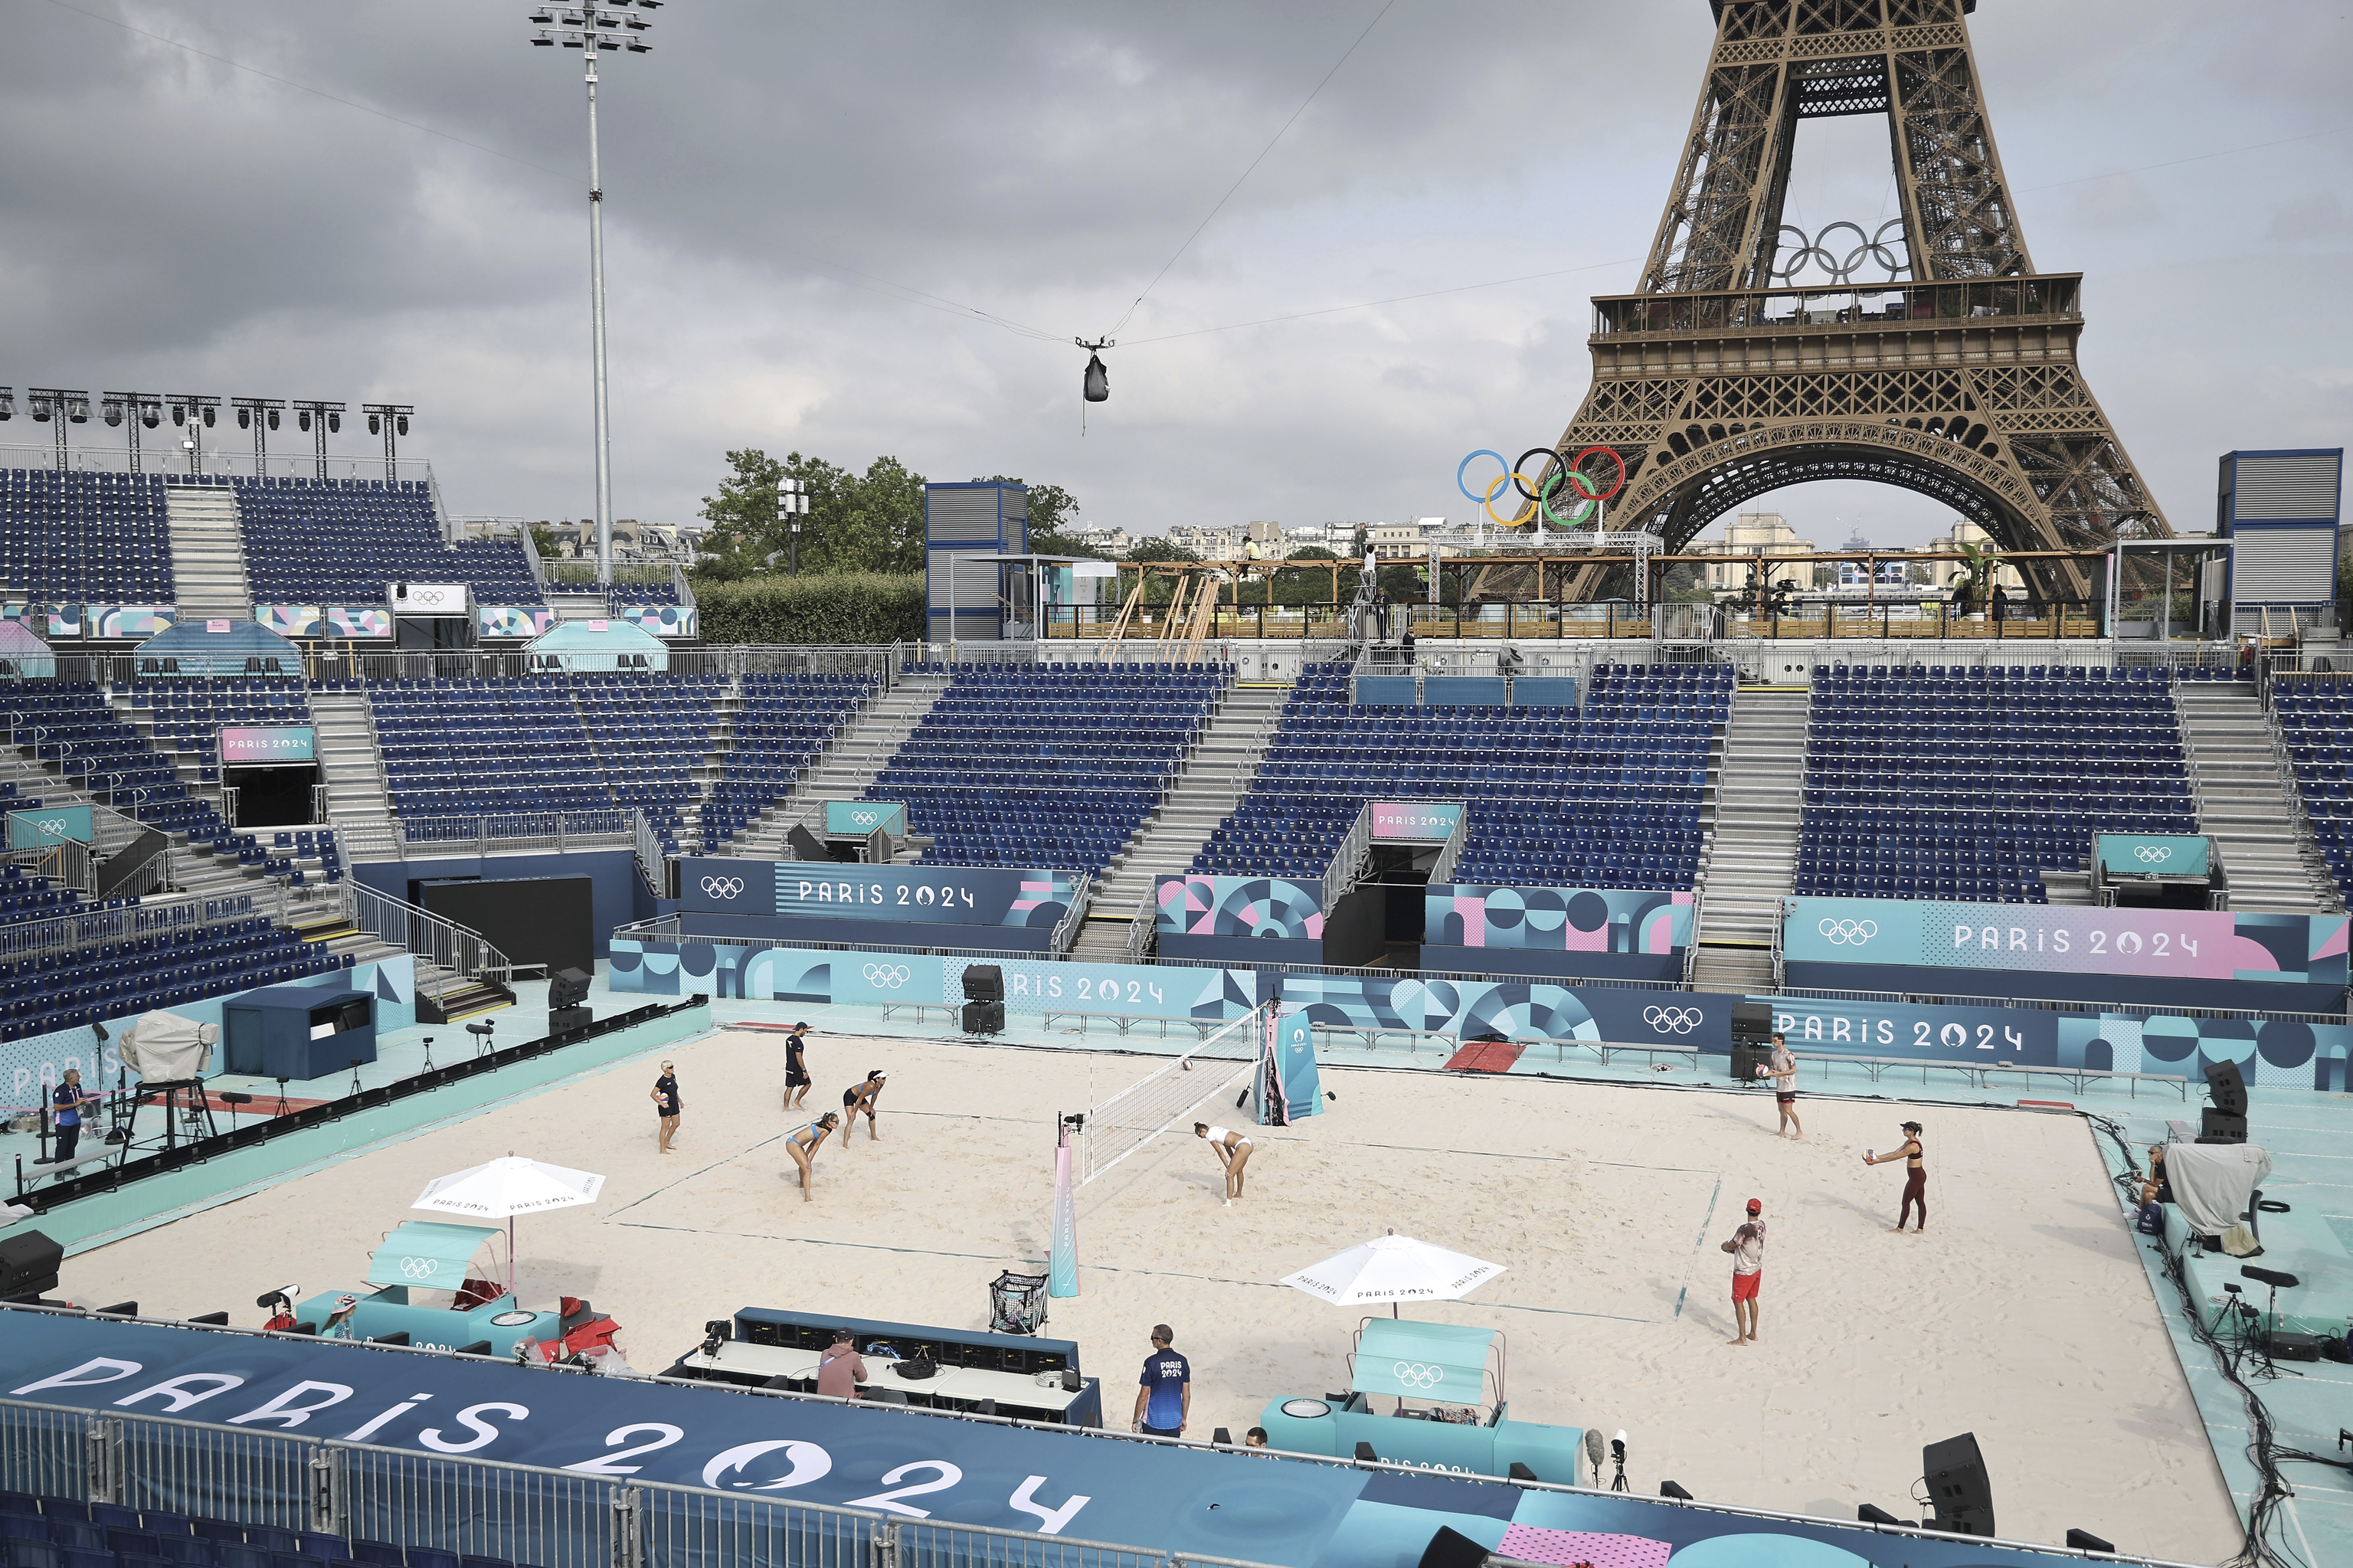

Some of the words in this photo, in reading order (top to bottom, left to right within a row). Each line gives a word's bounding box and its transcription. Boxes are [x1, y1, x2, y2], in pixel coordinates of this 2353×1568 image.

[273, 739, 307, 748] 2024
[1421, 817, 1455, 827] 2024
[799, 881, 884, 905] PARiS
[896, 885, 974, 908] 2024
[1955, 925, 2070, 953] PARiS
[2090, 930, 2198, 957] 2024
[1002, 973, 1062, 997] RiS
[1077, 977, 1163, 1004] 2024
[1778, 1013, 1894, 1045] PARiS
[1913, 1020, 2022, 1051] 2024
[545, 1196, 574, 1205] 2024
[463, 1203, 489, 1212] 2024
[1471, 1266, 1491, 1278] 2024
[1317, 1284, 1337, 1296] 2024
[1399, 1288, 1434, 1296] 2024
[1160, 1360, 1182, 1370] PARIS
[1161, 1369, 1182, 1378] 2024
[9, 1357, 529, 1453] PARiS
[559, 1422, 1091, 1534] 2024
